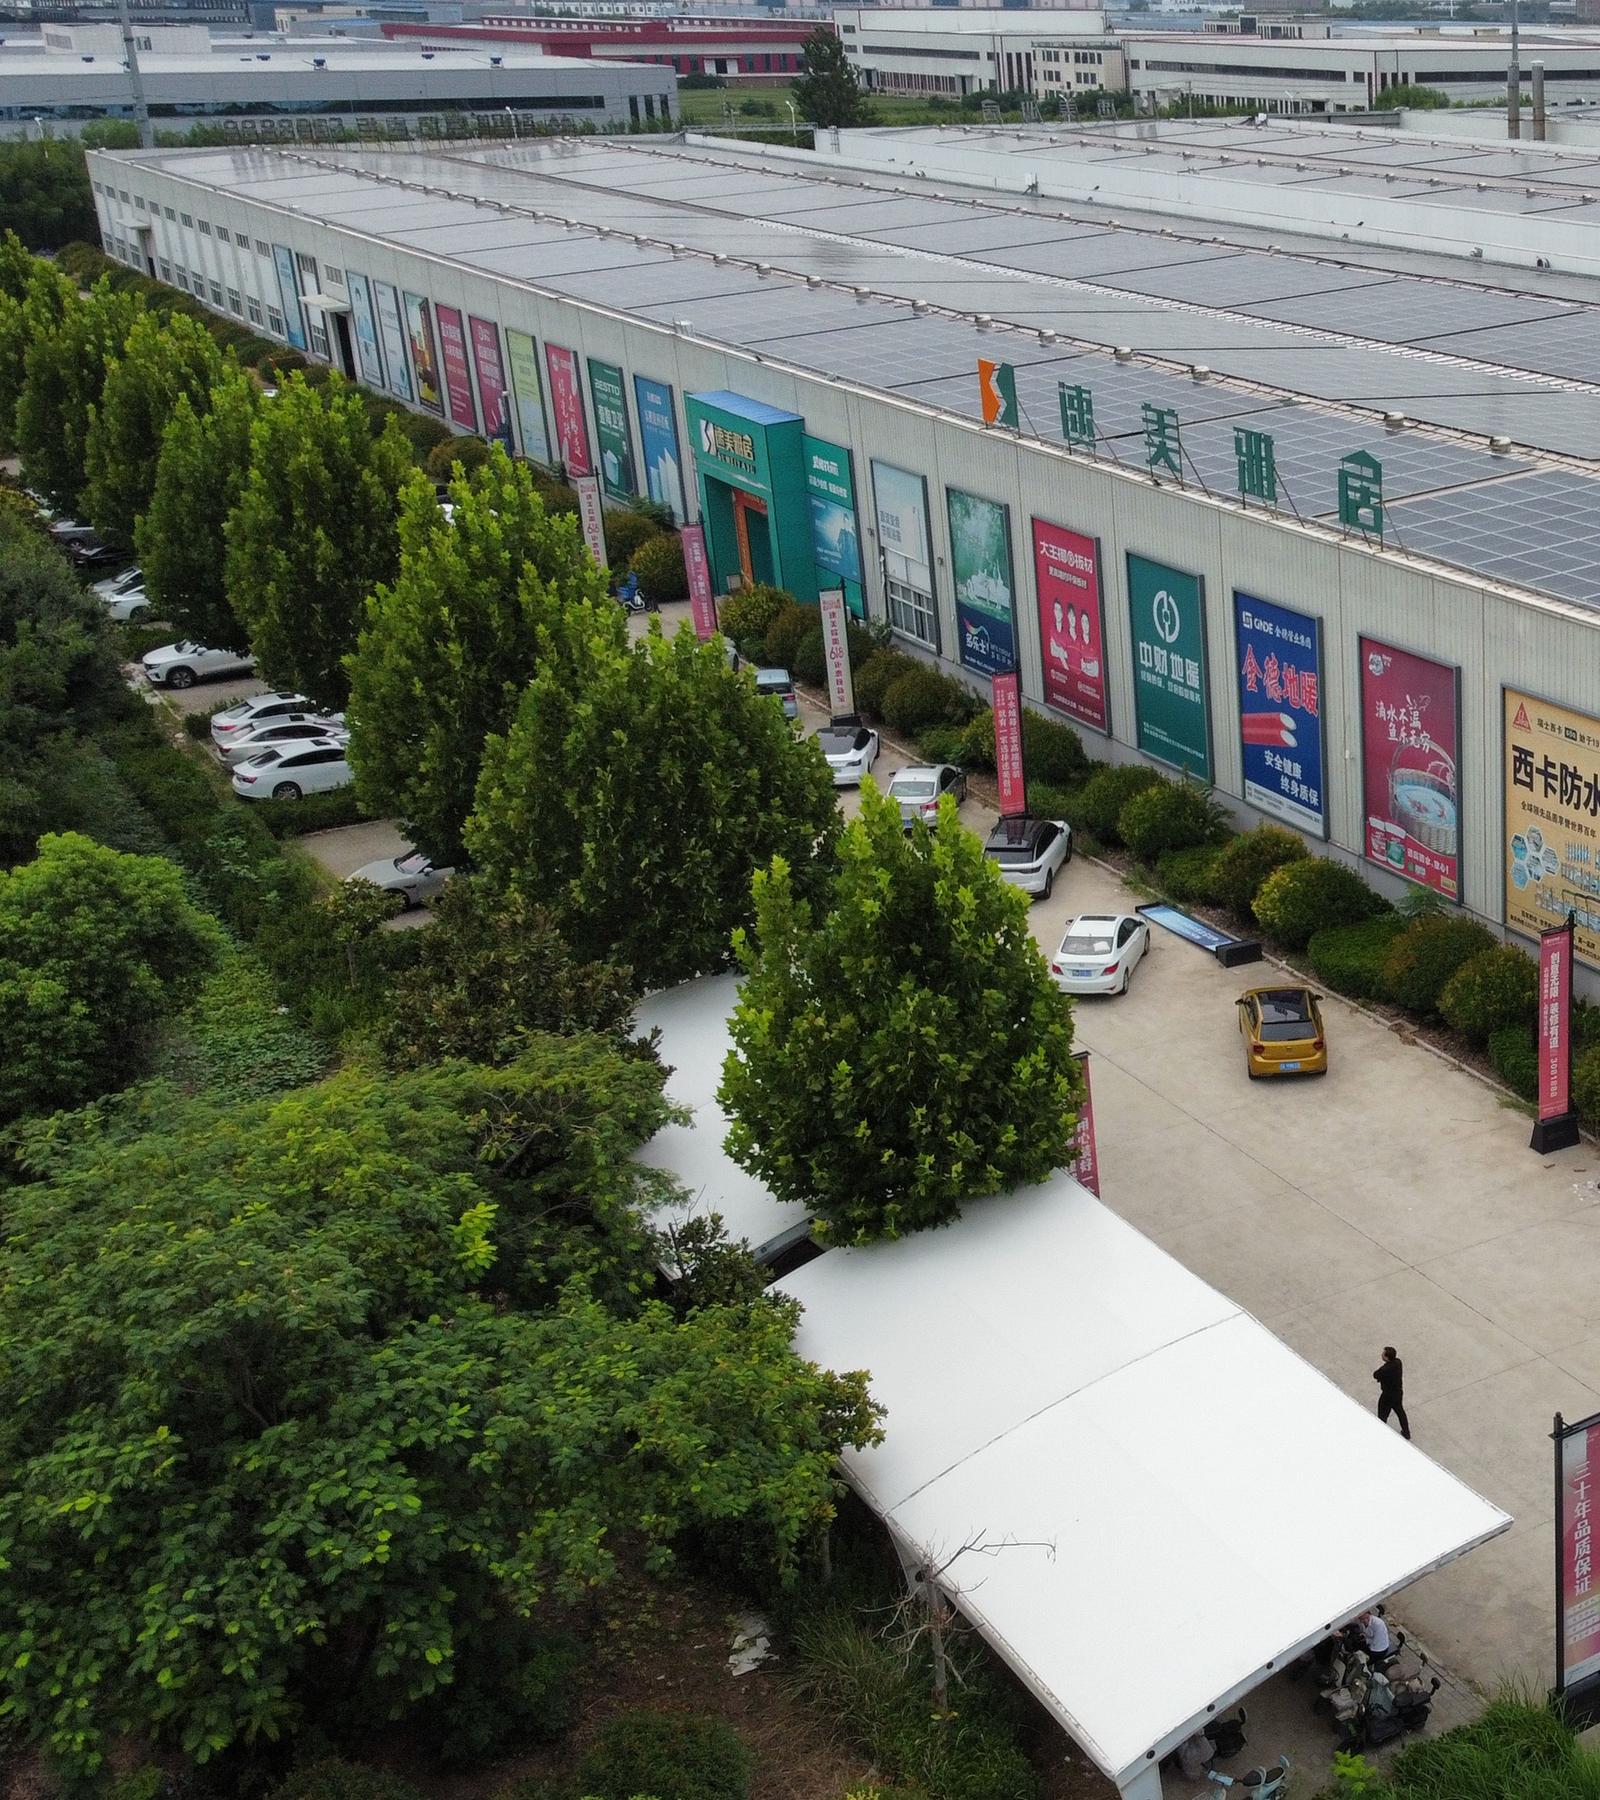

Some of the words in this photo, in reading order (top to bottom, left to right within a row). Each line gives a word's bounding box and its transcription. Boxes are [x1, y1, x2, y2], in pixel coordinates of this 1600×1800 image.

[1139, 641, 1200, 690] 中财地暖
[1242, 643, 1319, 717] 金德地暖
[1375, 700, 1422, 731] 滴水不漏
[1387, 722, 1431, 753] 鱼乐无穷
[1264, 750, 1302, 780] 安全健康
[1280, 775, 1319, 807] 终身质保
[1573, 1460, 1591, 1597] 三十年品质保证
